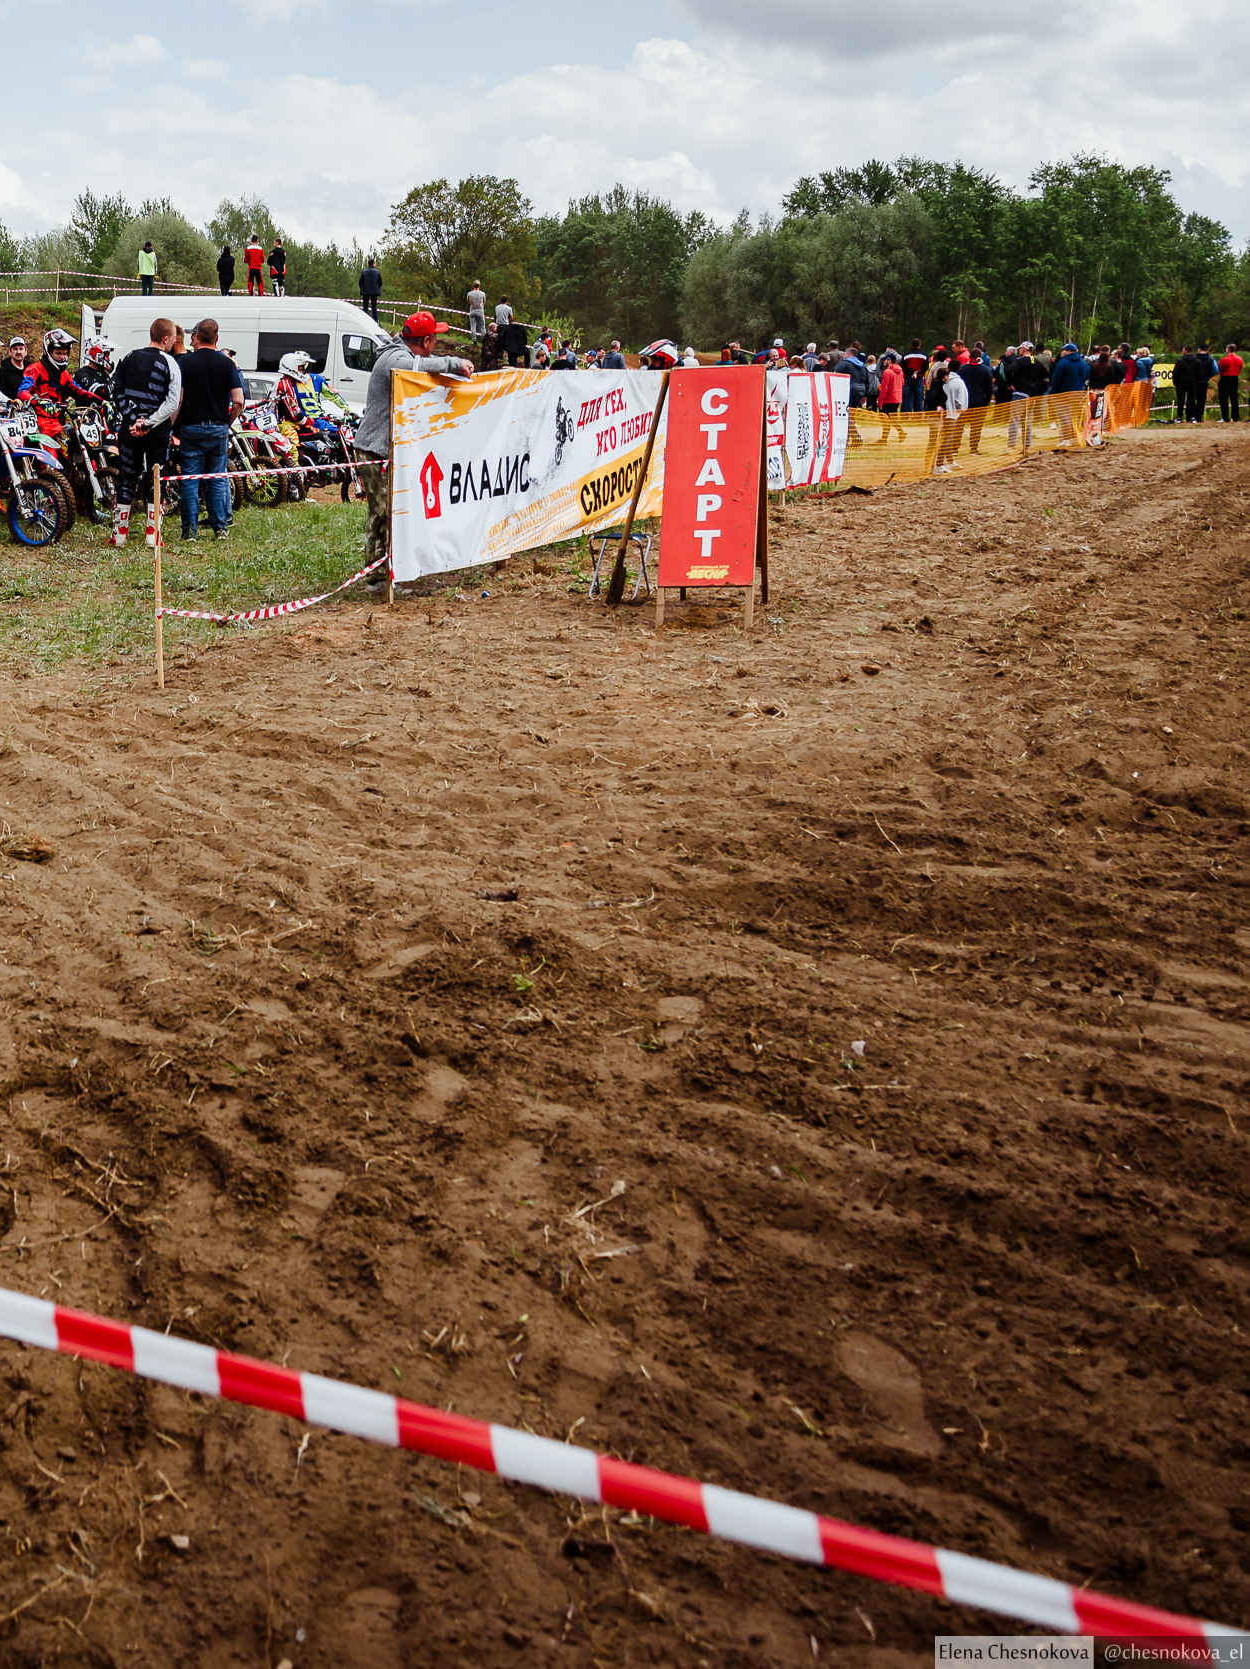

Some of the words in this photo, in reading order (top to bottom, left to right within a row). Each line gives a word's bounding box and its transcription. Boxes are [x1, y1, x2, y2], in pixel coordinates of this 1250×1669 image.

[7, 426, 22, 437] 84
[263, 416, 272, 426] 3
[577, 396, 603, 432] ДЛЯ
[605, 387, 627, 417] ТЕХ,
[86, 429, 98, 439] 45
[596, 425, 617, 457] КТО
[620, 411, 654, 447] ЛЮБИТ
[449, 452, 531, 505] ВЛАДИС
[693, 387, 729, 557] СТАРТ
